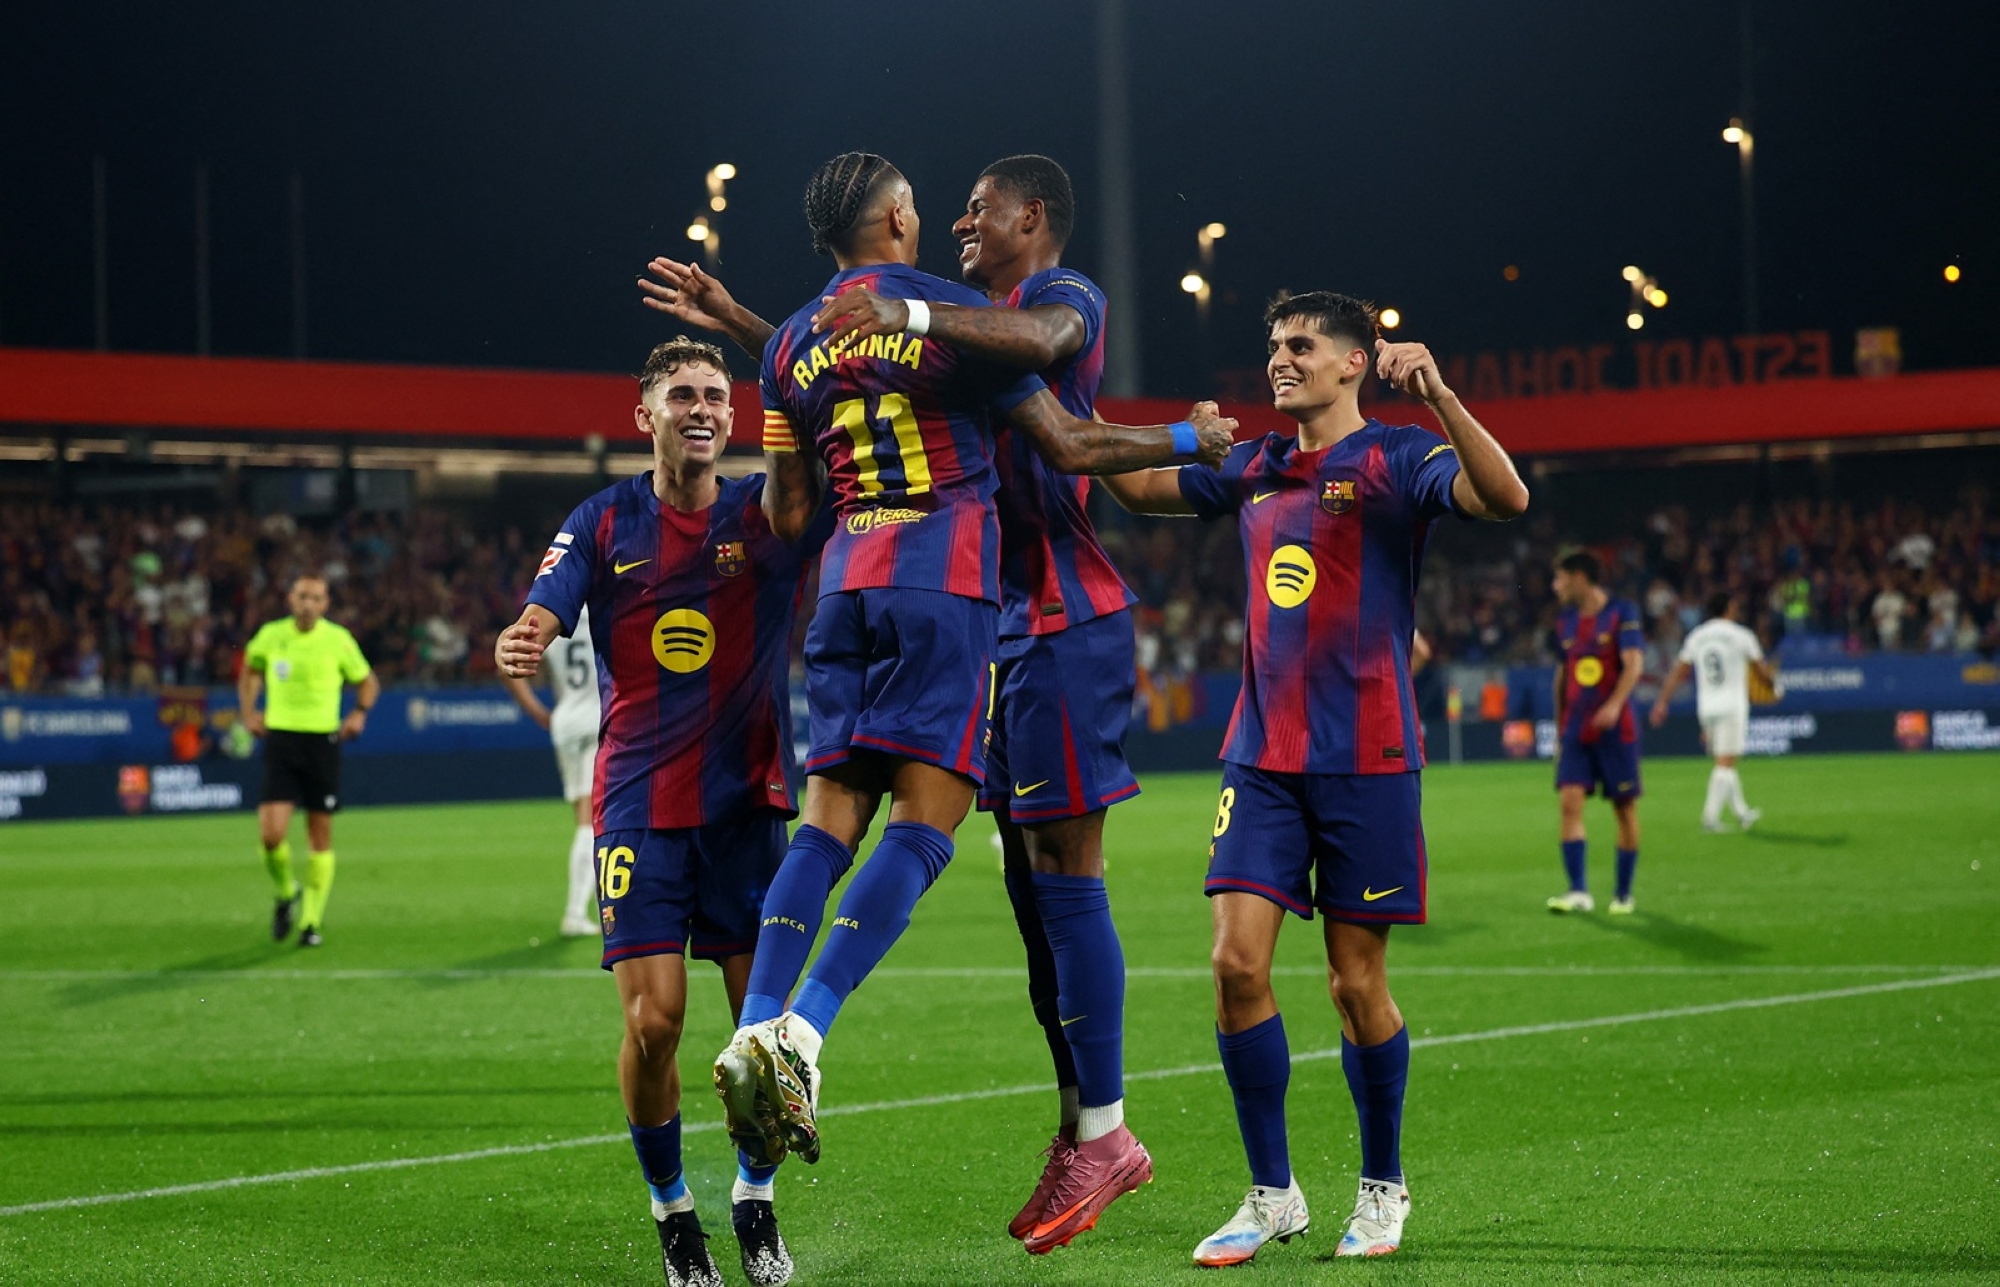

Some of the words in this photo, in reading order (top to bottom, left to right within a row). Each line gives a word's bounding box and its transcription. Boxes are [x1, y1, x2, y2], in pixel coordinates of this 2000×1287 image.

[831, 393, 934, 500] 11
[567, 641, 590, 690] 5
[597, 845, 635, 901] 16
